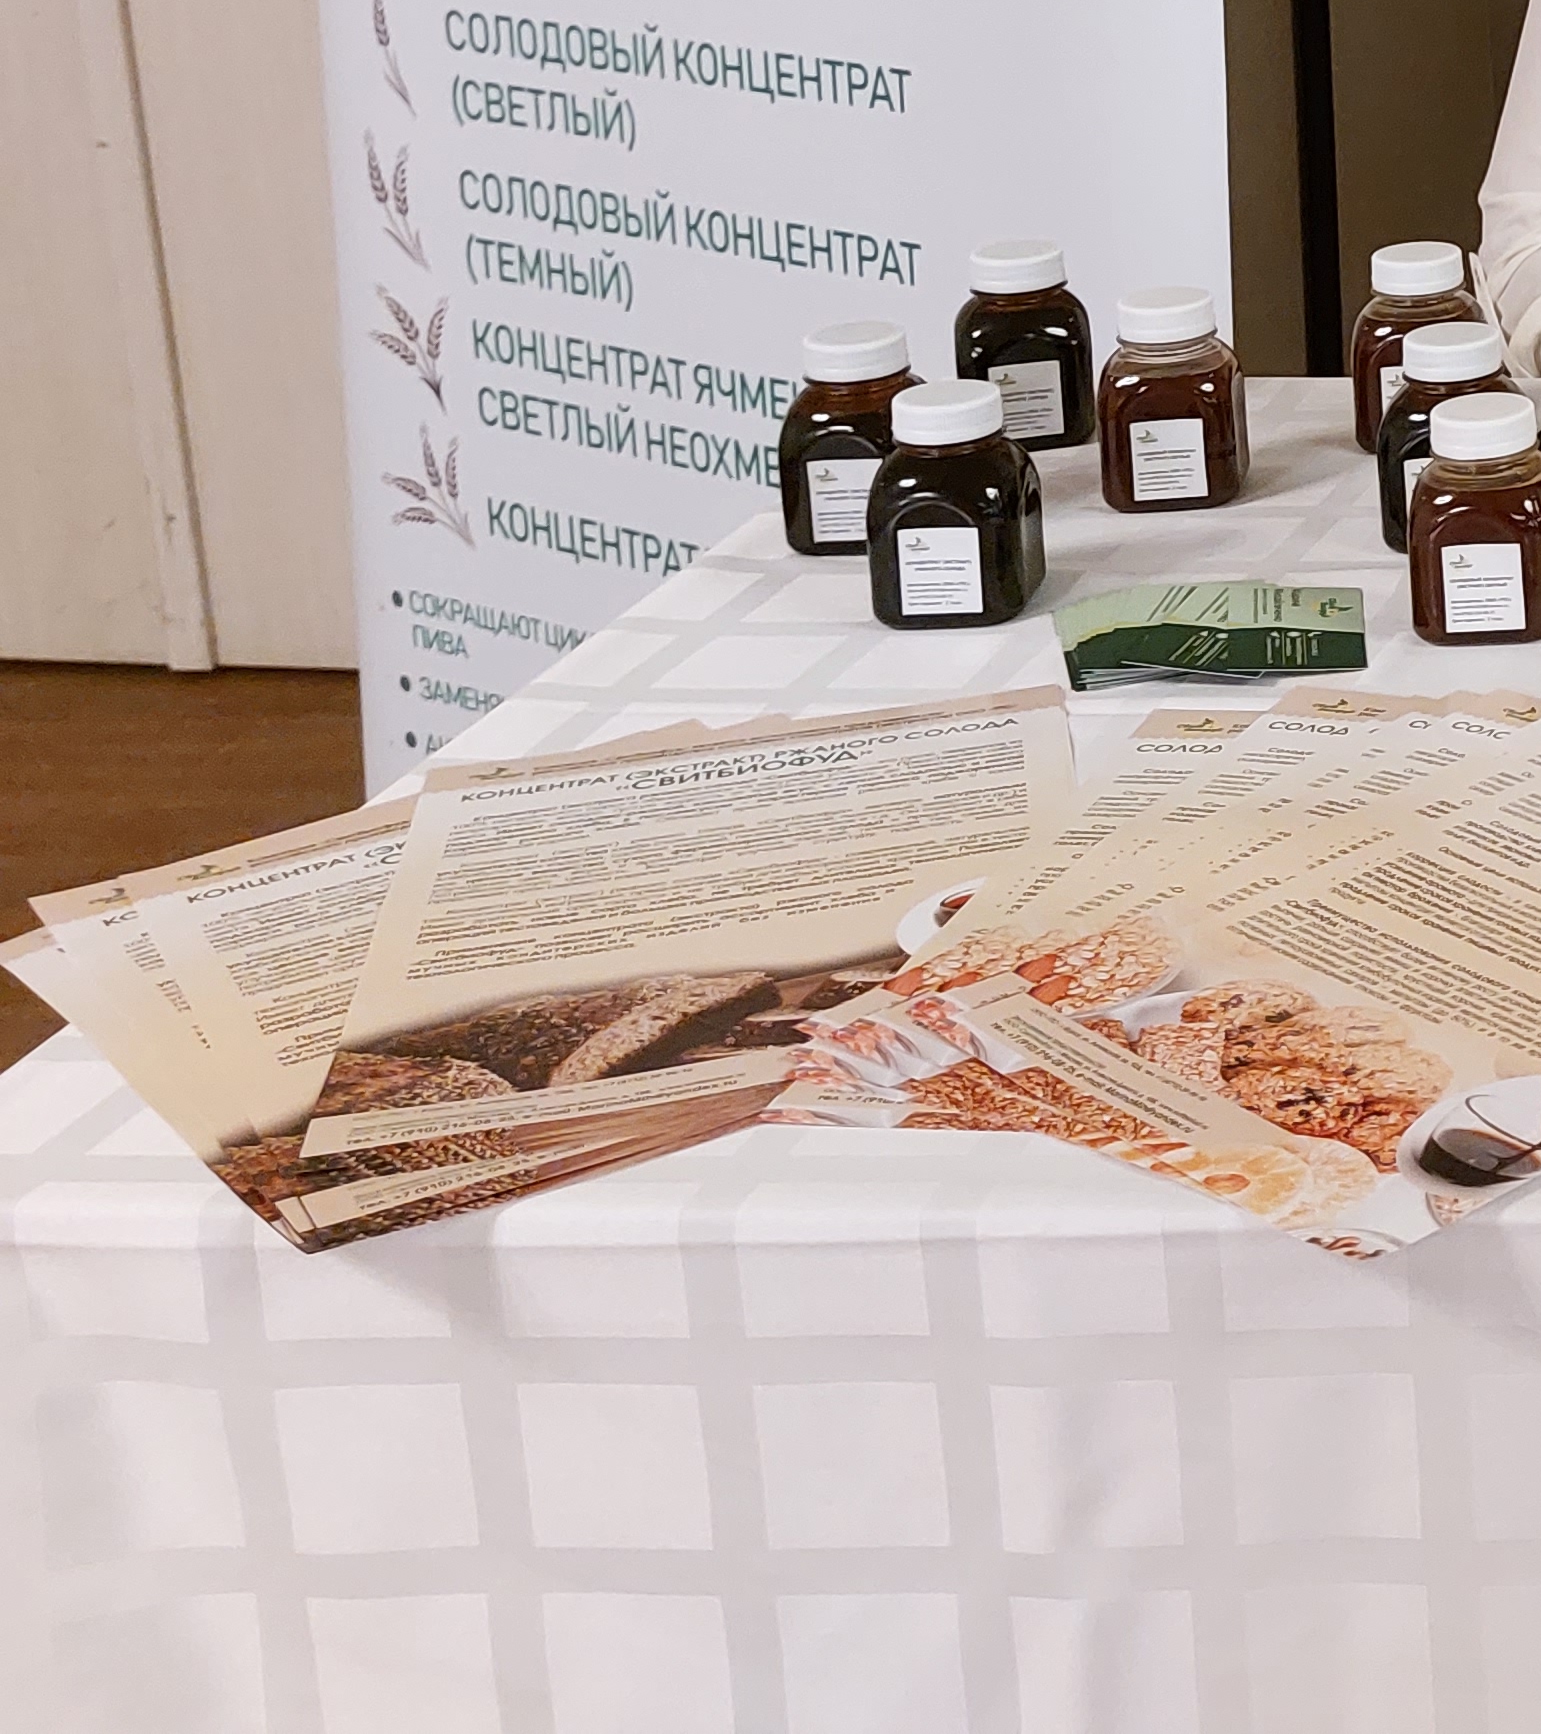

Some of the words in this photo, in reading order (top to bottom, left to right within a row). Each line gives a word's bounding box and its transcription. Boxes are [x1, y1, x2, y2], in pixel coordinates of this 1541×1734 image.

[445, 9, 666, 80] СОЛОДОВЫЙ
[673, 38, 913, 114] КОНЦЕНТРАТ
[452, 74, 637, 152] (СВЕТЛЫЙ)
[458, 169, 677, 245] СОЛОДОВЫЙ
[685, 205, 922, 287] КОНЦЕНТРАТ
[465, 233, 634, 313] (ТЕМНЫЙ)
[472, 319, 687, 401] КОНЦЕНТРАТ
[478, 386, 638, 459] СВЕТЛЫЙ
[487, 497, 700, 578] КОНЦЕНТРАТ
[408, 590, 541, 643] СОКРАЩАЮТ
[412, 624, 470, 658] ПИВА
[460, 774, 616, 803] КОНЦЕНТРАТ
[625, 751, 766, 781] (ЭКСТРАКТ)
[774, 735, 898, 759] РЖАНОГО
[904, 718, 1019, 740] СОЛОДА
[616, 749, 873, 791] «СВИТБИОФУД»
[186, 854, 355, 903] КОНЦЕНТРАТ
